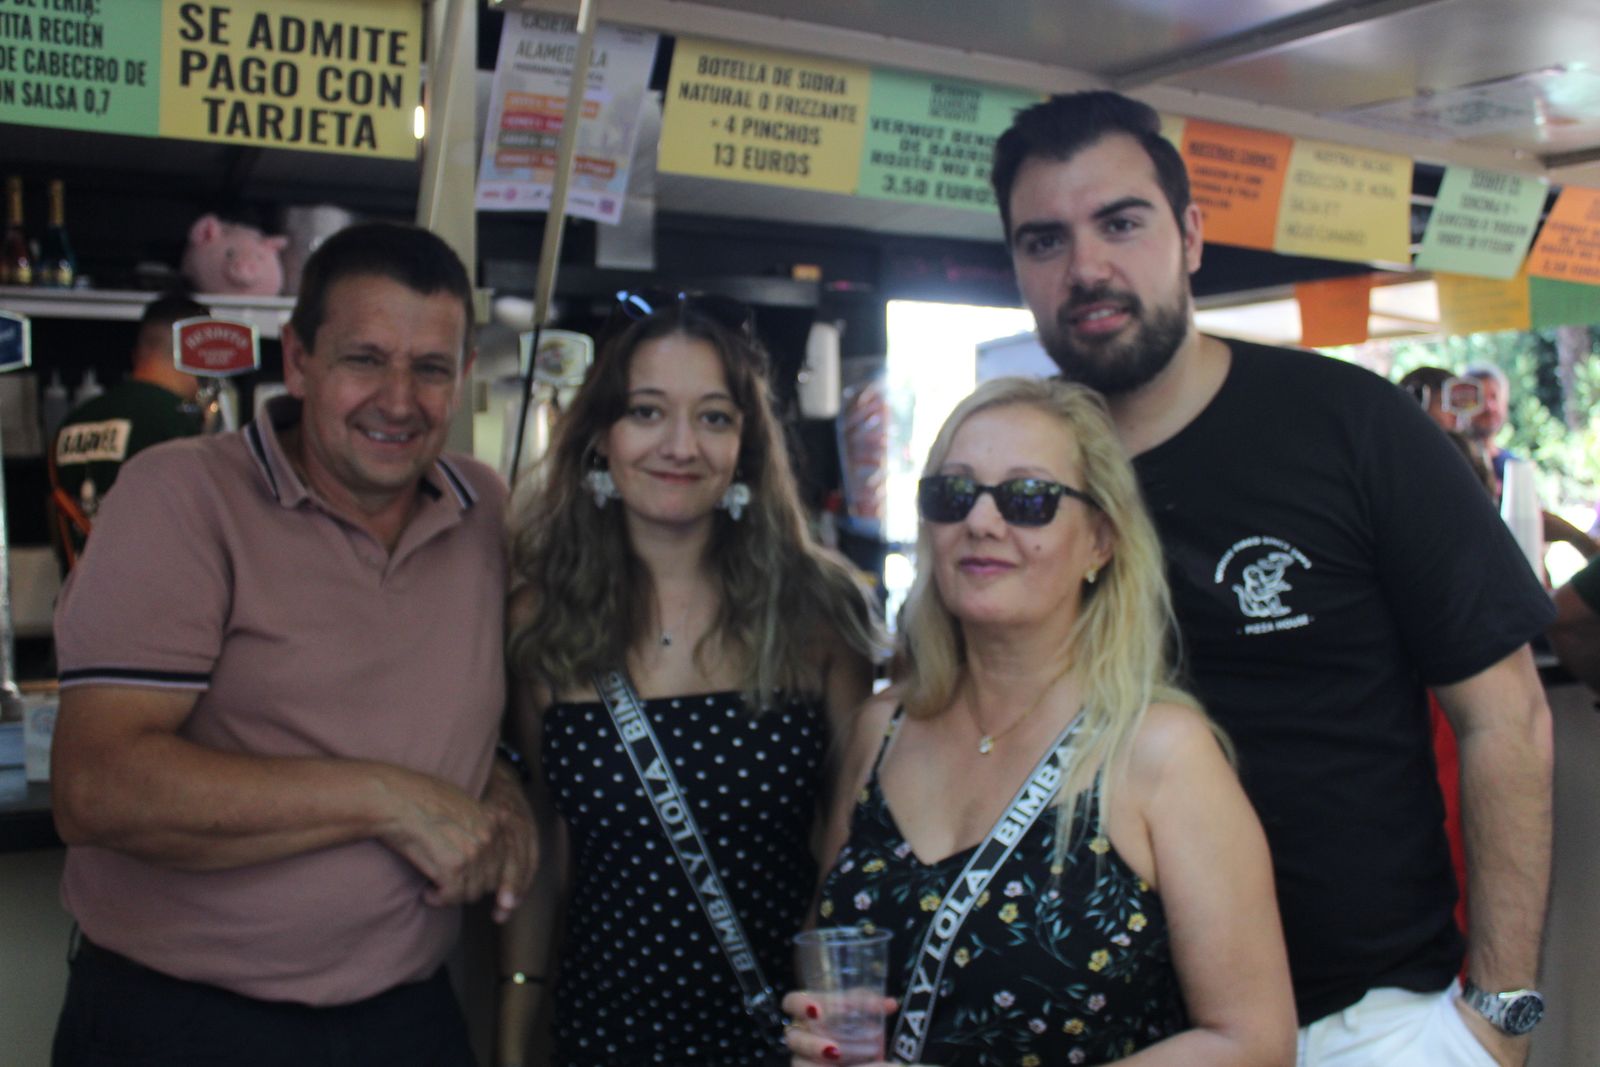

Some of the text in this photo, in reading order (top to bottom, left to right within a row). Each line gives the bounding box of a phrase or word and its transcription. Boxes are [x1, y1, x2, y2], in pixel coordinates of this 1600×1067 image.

[179, 3, 409, 67] SE ADMITE
[24, 48, 119, 84] CABECERO
[125, 60, 147, 87] DE
[180, 49, 402, 109] PAGO CON
[697, 55, 847, 96] BOTELLA DE SIDRA
[0, 80, 15, 105] N
[22, 80, 77, 111] SALSA
[679, 81, 753, 109] NATURAL
[775, 94, 858, 124] FRIZZANTE
[203, 96, 378, 149] TARJETA
[725, 115, 736, 135] 4
[742, 118, 821, 146] PINCHOS
[714, 143, 812, 176] 13 EUROS
[644, 756, 694, 841] LOLA
[681, 850, 704, 874] Y
[699, 873, 756, 973] BIMBA
[913, 967, 935, 995] Y
[926, 868, 991, 962] LOLA
